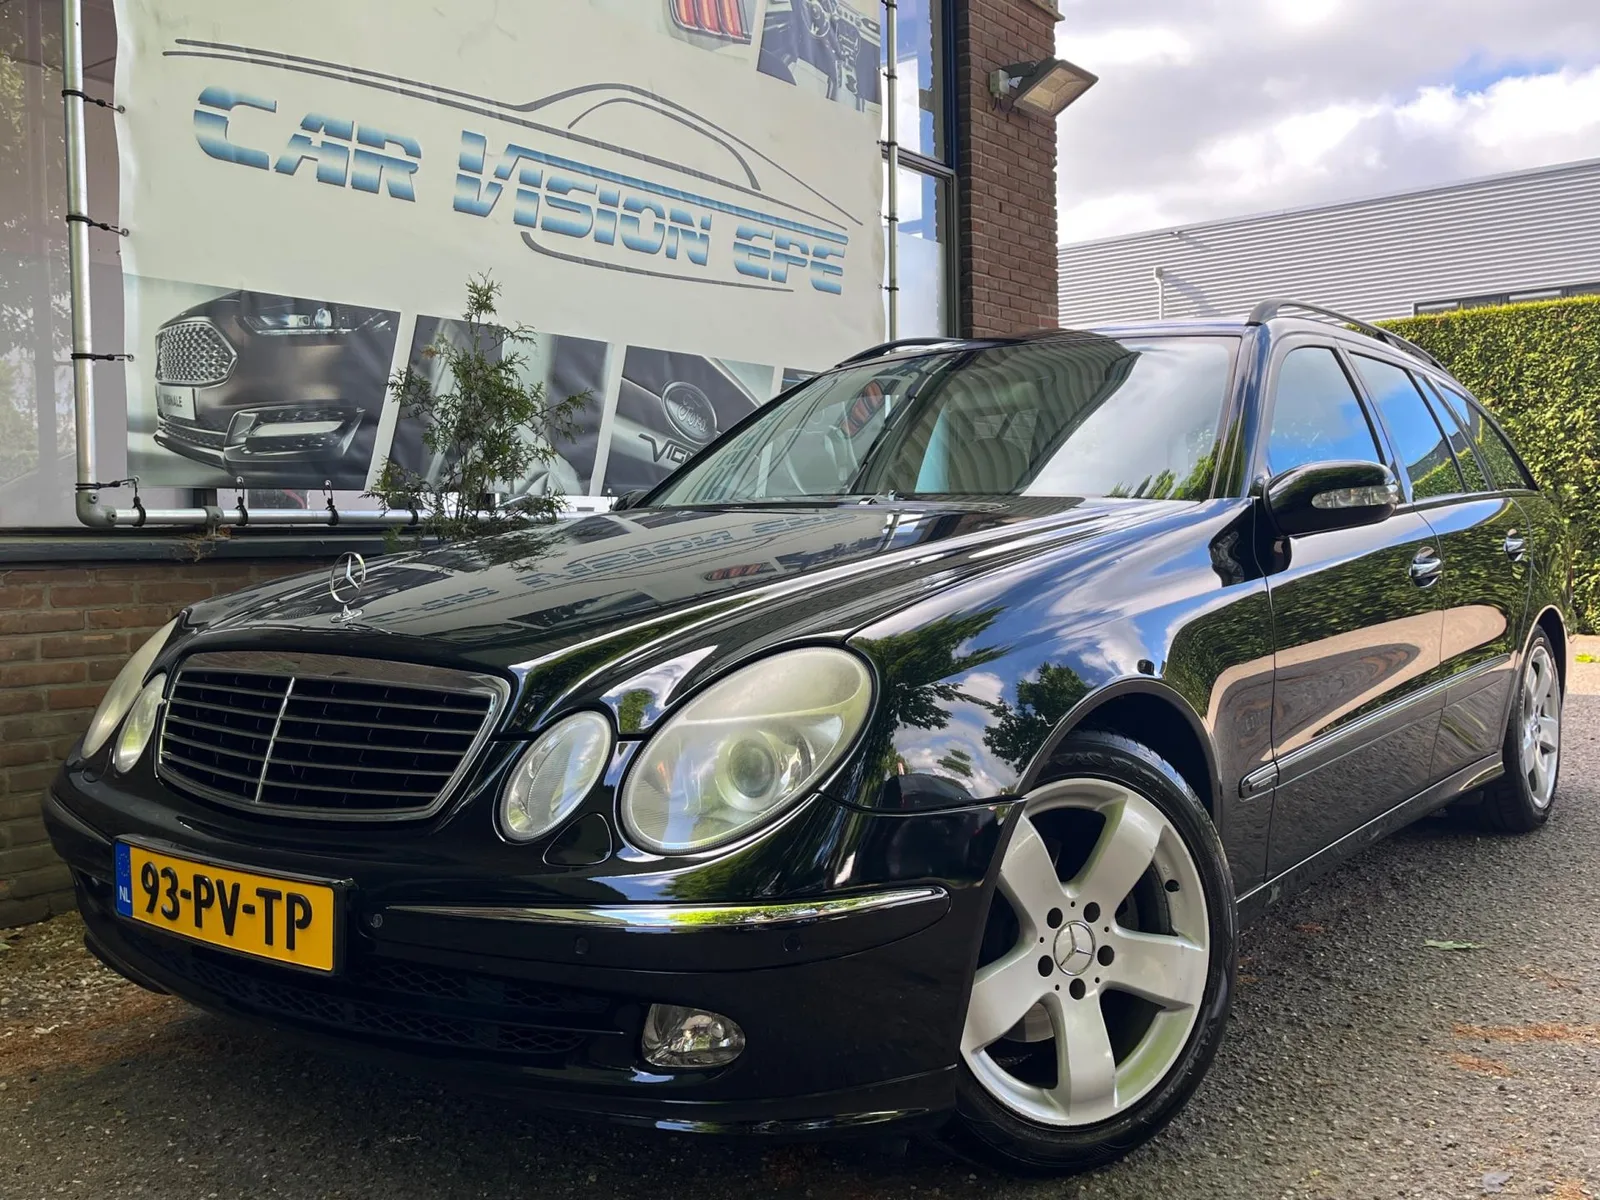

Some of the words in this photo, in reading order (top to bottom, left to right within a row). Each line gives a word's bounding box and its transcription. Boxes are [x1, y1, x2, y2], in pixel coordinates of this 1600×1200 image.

[193, 85, 421, 201] CAR
[453, 130, 711, 266] VISION
[733, 224, 846, 295] EPE
[119, 885, 131, 903] NL
[141, 861, 312, 950] 93-PV-TP
